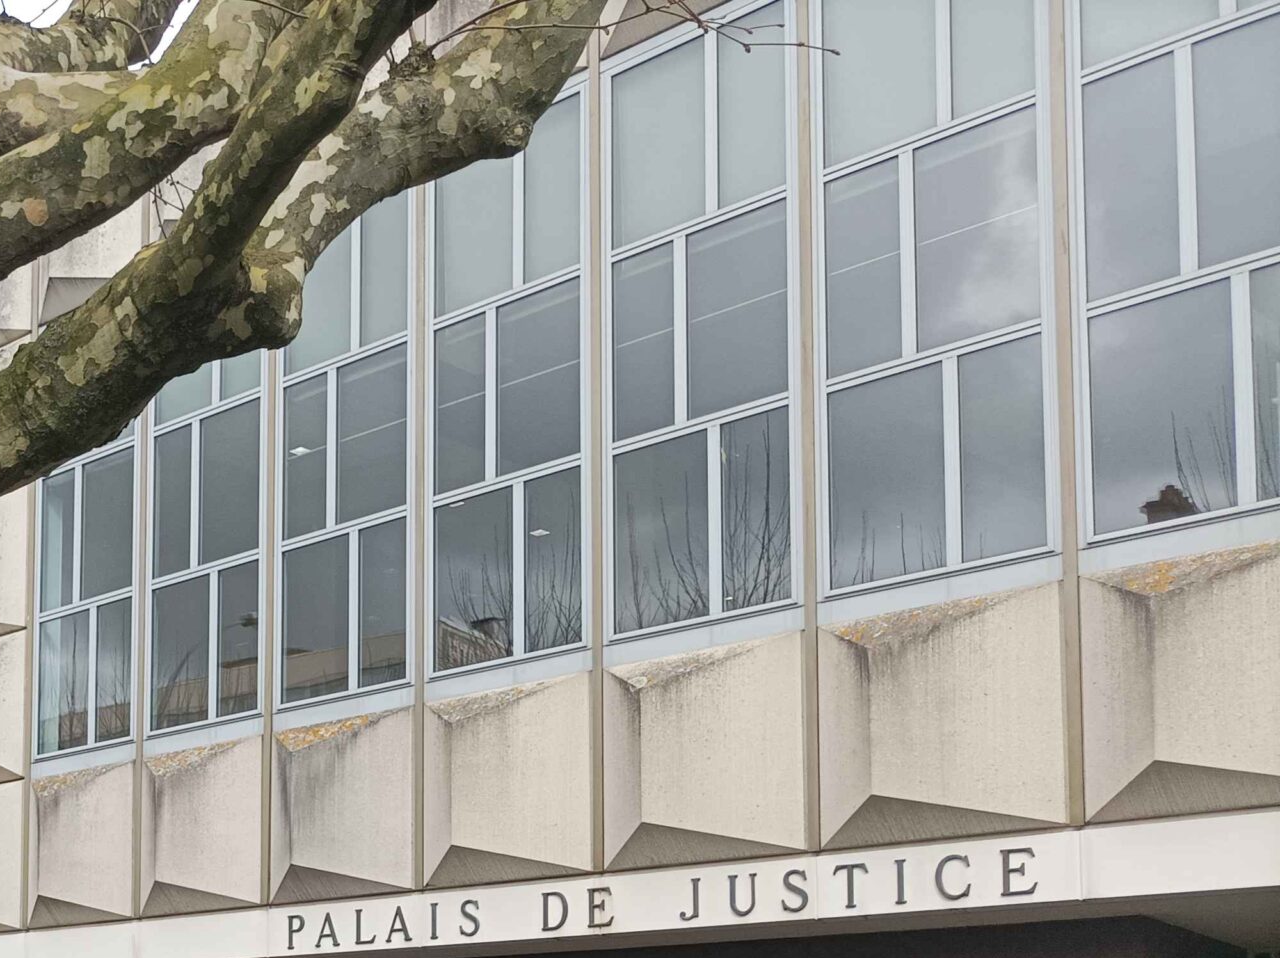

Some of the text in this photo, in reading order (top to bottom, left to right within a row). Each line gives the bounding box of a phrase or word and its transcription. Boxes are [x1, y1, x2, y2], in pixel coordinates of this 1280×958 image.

[286, 847, 1039, 950] PALAIS DE JUSTICE
